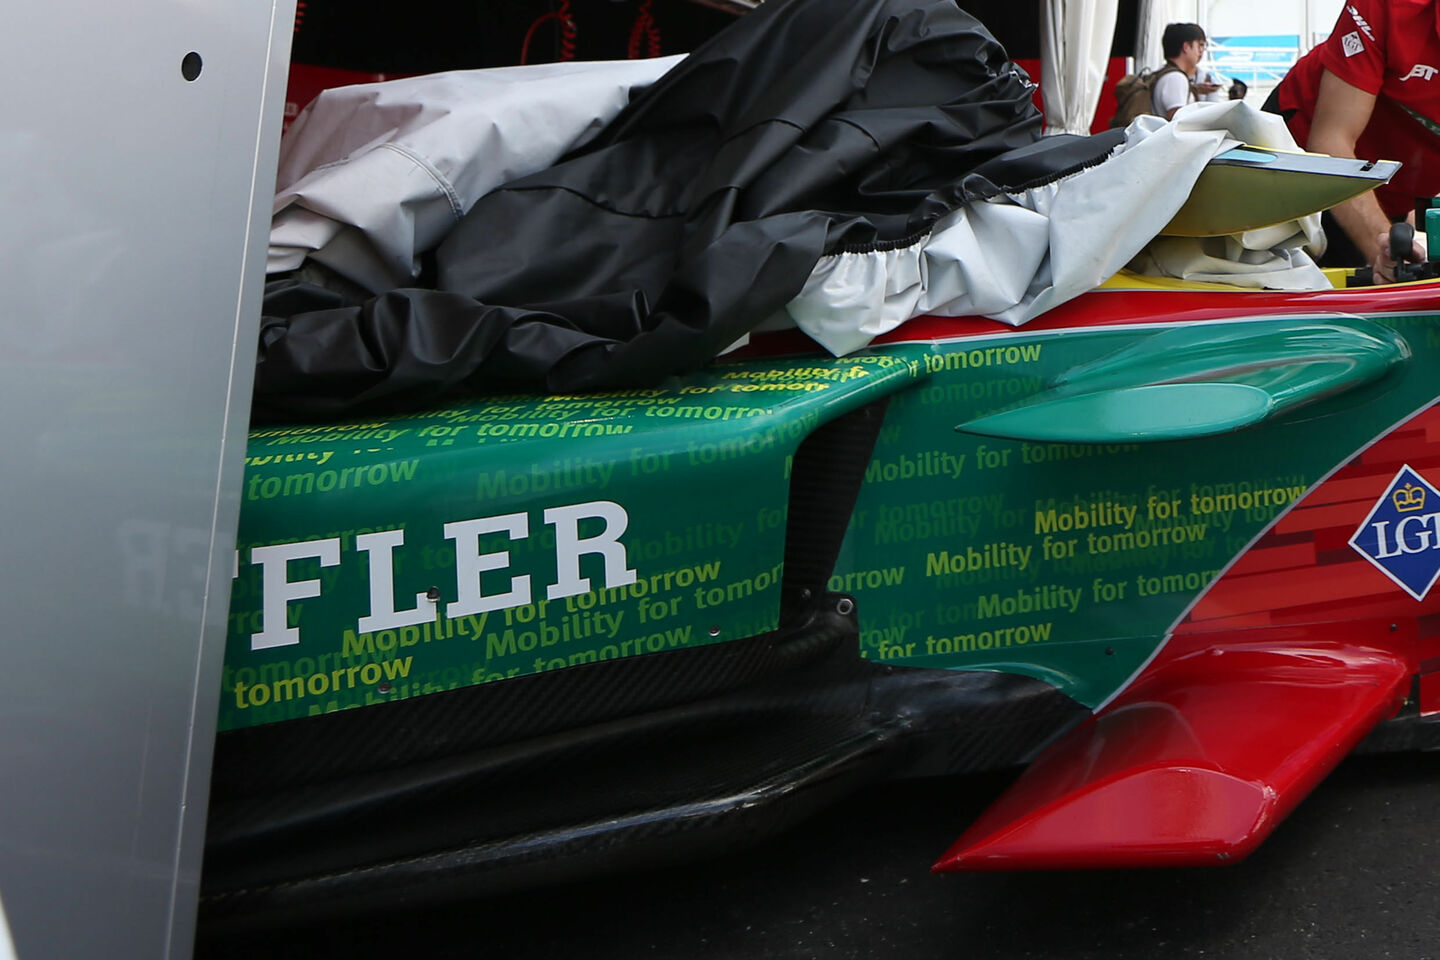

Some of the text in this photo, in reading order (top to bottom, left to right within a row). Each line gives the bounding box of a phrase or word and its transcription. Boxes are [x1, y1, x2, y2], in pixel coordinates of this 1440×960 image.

[923, 343, 1042, 374] tomorrow
[417, 424, 469, 438] for
[247, 459, 420, 501] tomorrow
[865, 449, 967, 484] Mobility
[975, 443, 1013, 471] for
[1033, 484, 1308, 536] Mobility for tomorrow
[925, 541, 1033, 578] Mobility
[1041, 534, 1079, 561] for
[1086, 522, 1208, 556] tomorrow
[827, 565, 906, 593] orrow
[976, 583, 1084, 621] Mobility
[1092, 577, 1129, 603] for
[341, 559, 722, 658] Mobility for tomorrow
[485, 561, 785, 660] Mobility for tomor
[925, 622, 1053, 656] tomorrow
[233, 654, 414, 710] tomorrow
